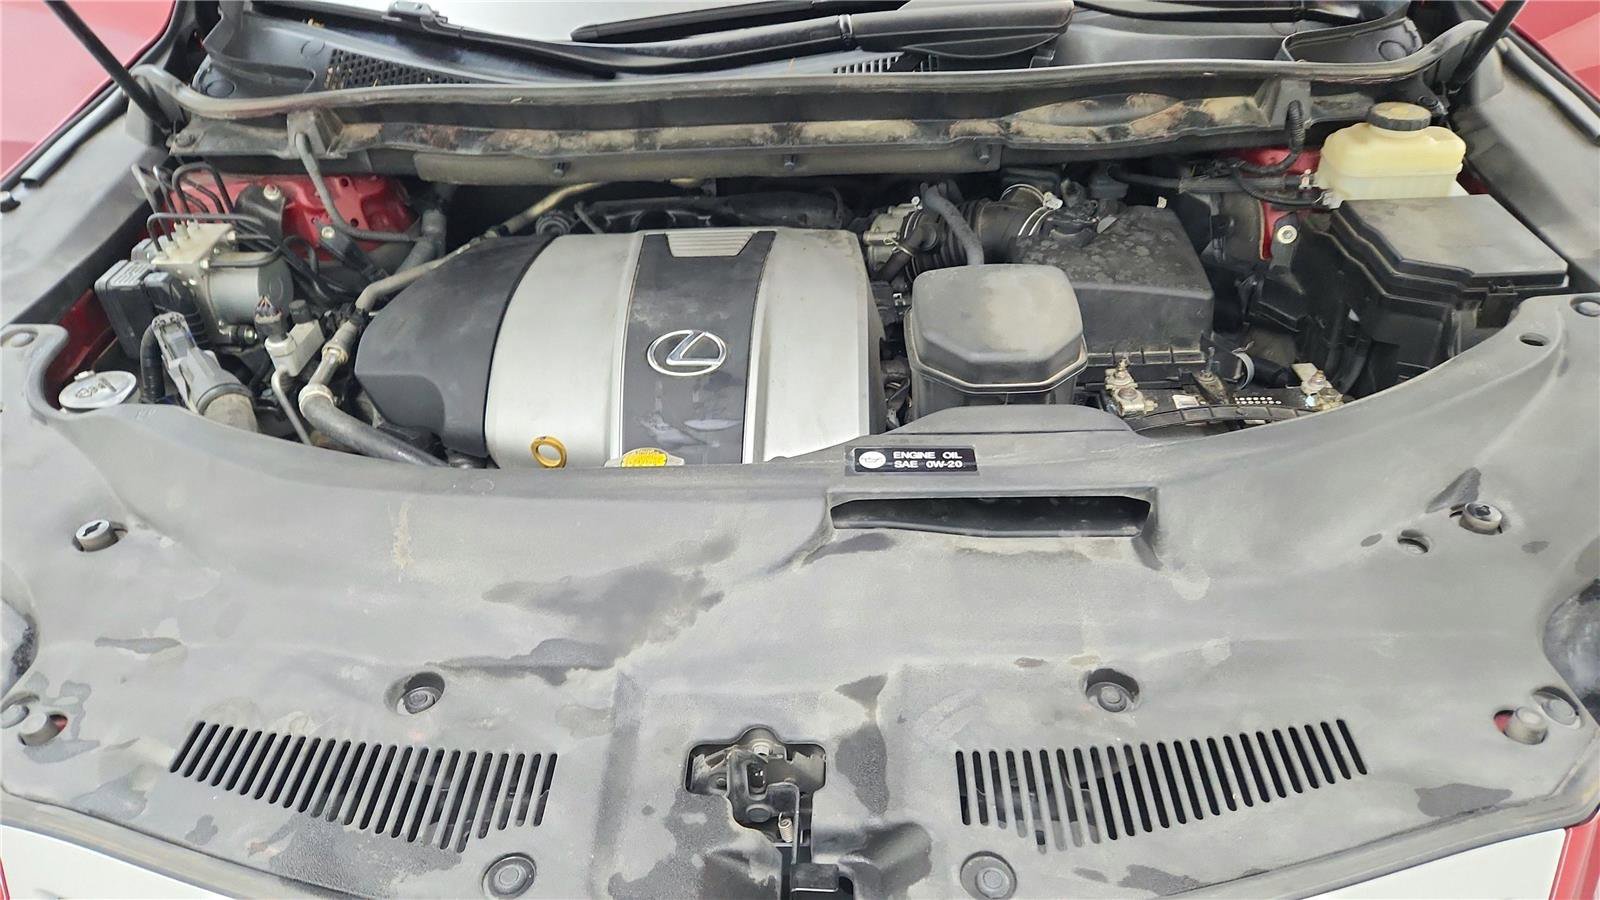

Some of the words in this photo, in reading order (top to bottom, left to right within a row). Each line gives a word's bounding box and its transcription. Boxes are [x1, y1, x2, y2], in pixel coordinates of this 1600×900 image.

[893, 451, 936, 459] ENGINE
[942, 451, 963, 459] OIL
[894, 460, 919, 468] SAE
[925, 460, 963, 468] 0W-20
